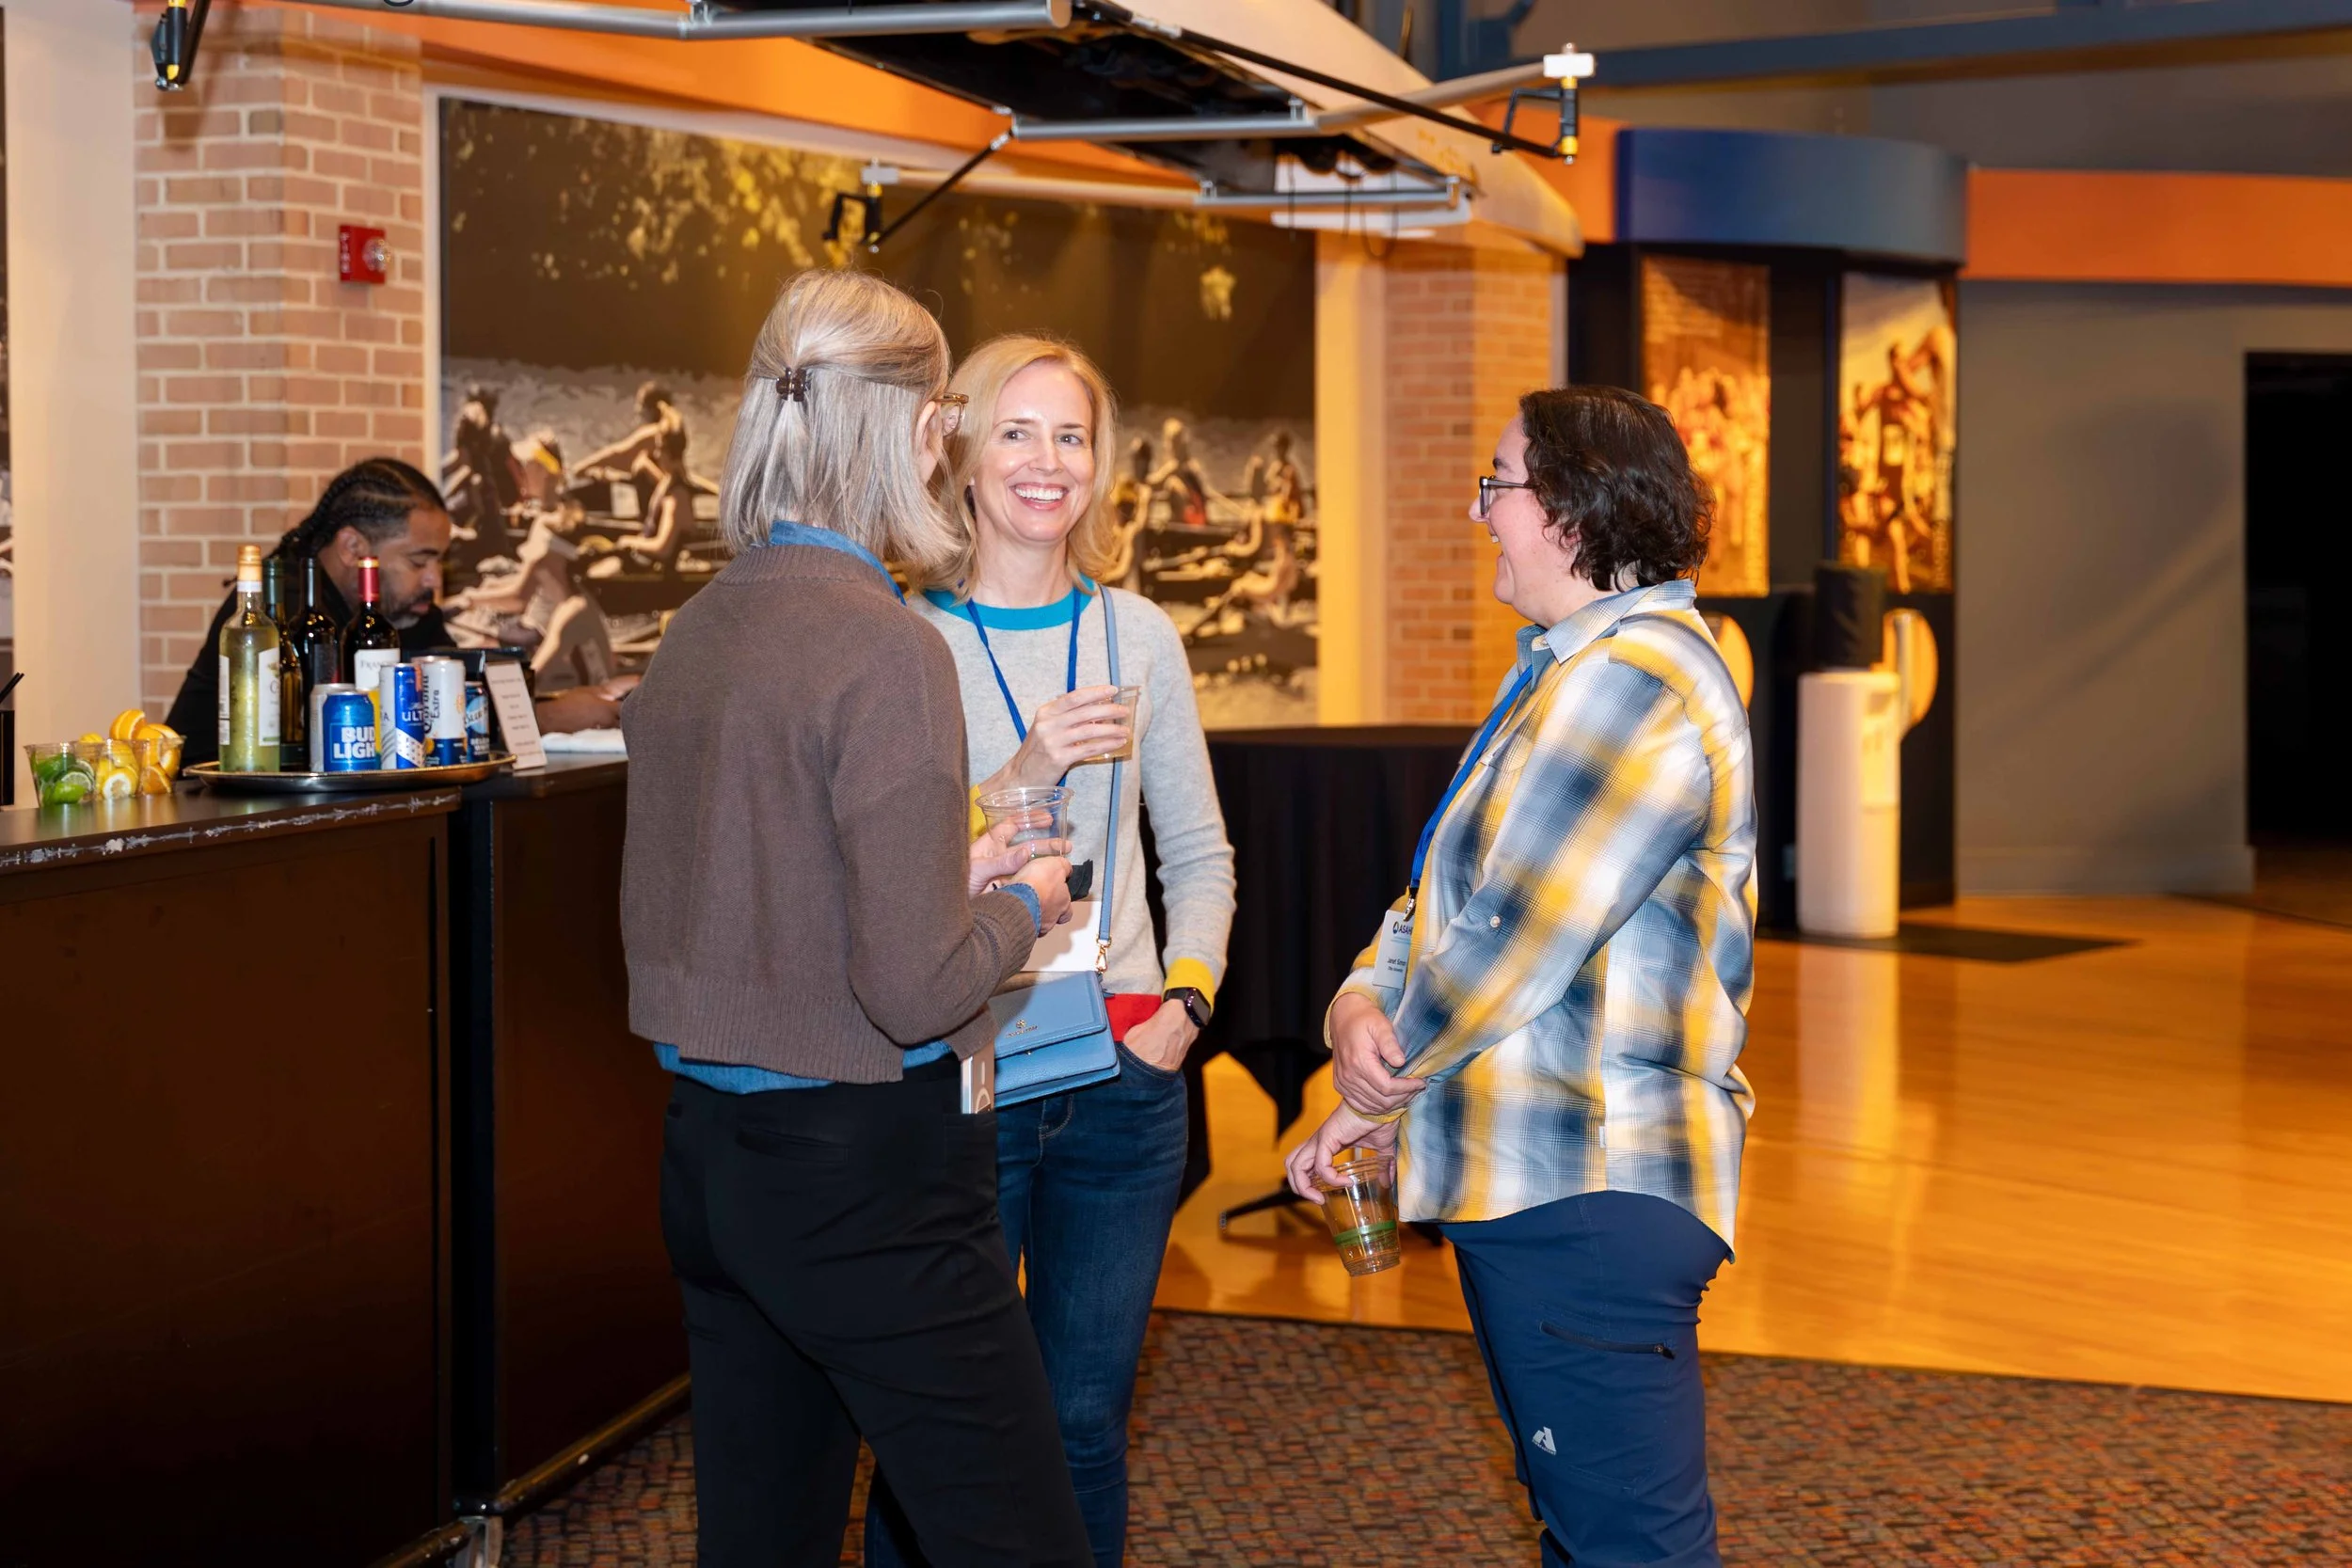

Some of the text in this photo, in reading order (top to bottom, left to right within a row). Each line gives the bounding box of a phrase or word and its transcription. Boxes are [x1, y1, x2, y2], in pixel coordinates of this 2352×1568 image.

[430, 689, 440, 719] Extra
[402, 710, 424, 721] ULT
[333, 742, 375, 759] LIGH
